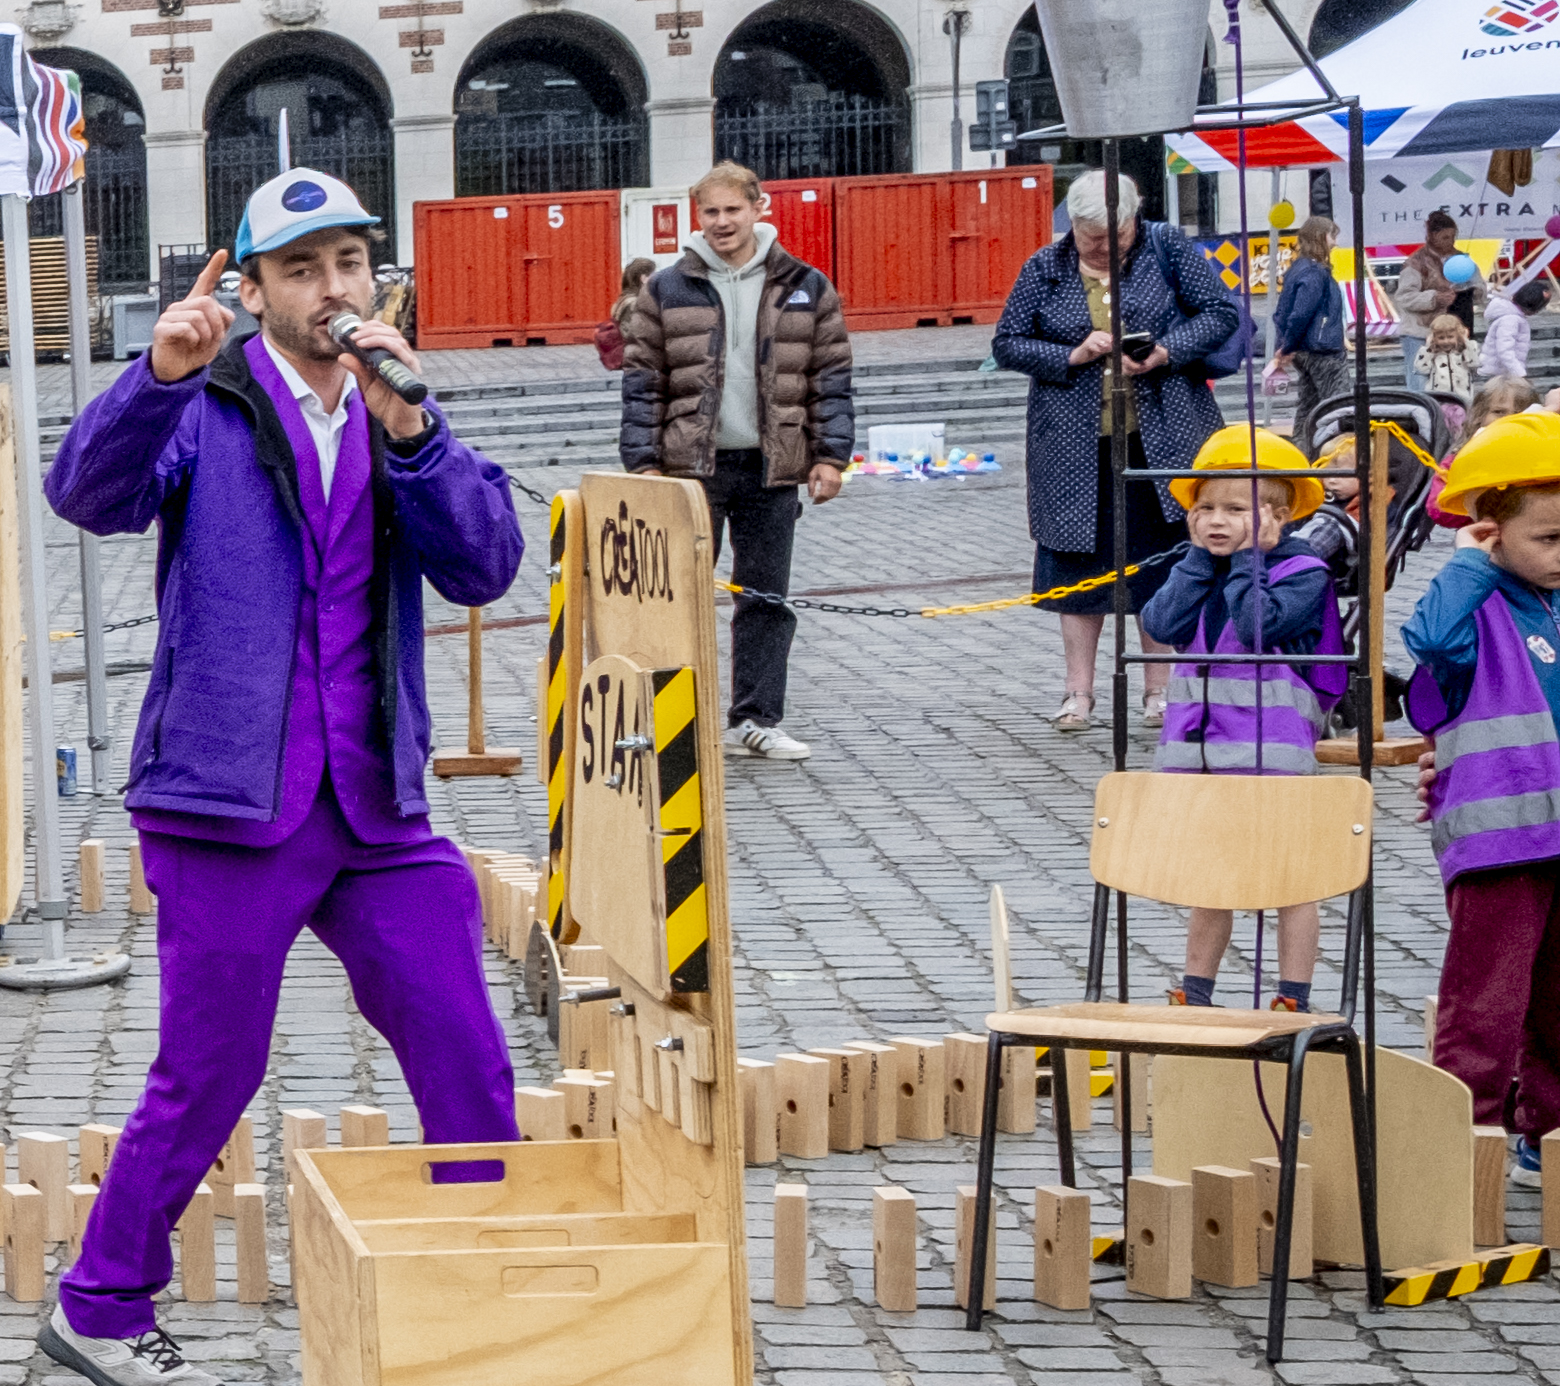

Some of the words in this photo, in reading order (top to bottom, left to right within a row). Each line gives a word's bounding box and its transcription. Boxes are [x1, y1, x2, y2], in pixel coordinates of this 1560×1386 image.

[1461, 39, 1560, 60] leuven
[978, 180, 987, 204] 1
[548, 205, 564, 228] 5
[1381, 210, 1422, 222] THE
[1439, 202, 1535, 217] EXTRA
[601, 500, 674, 602] CREATOOL
